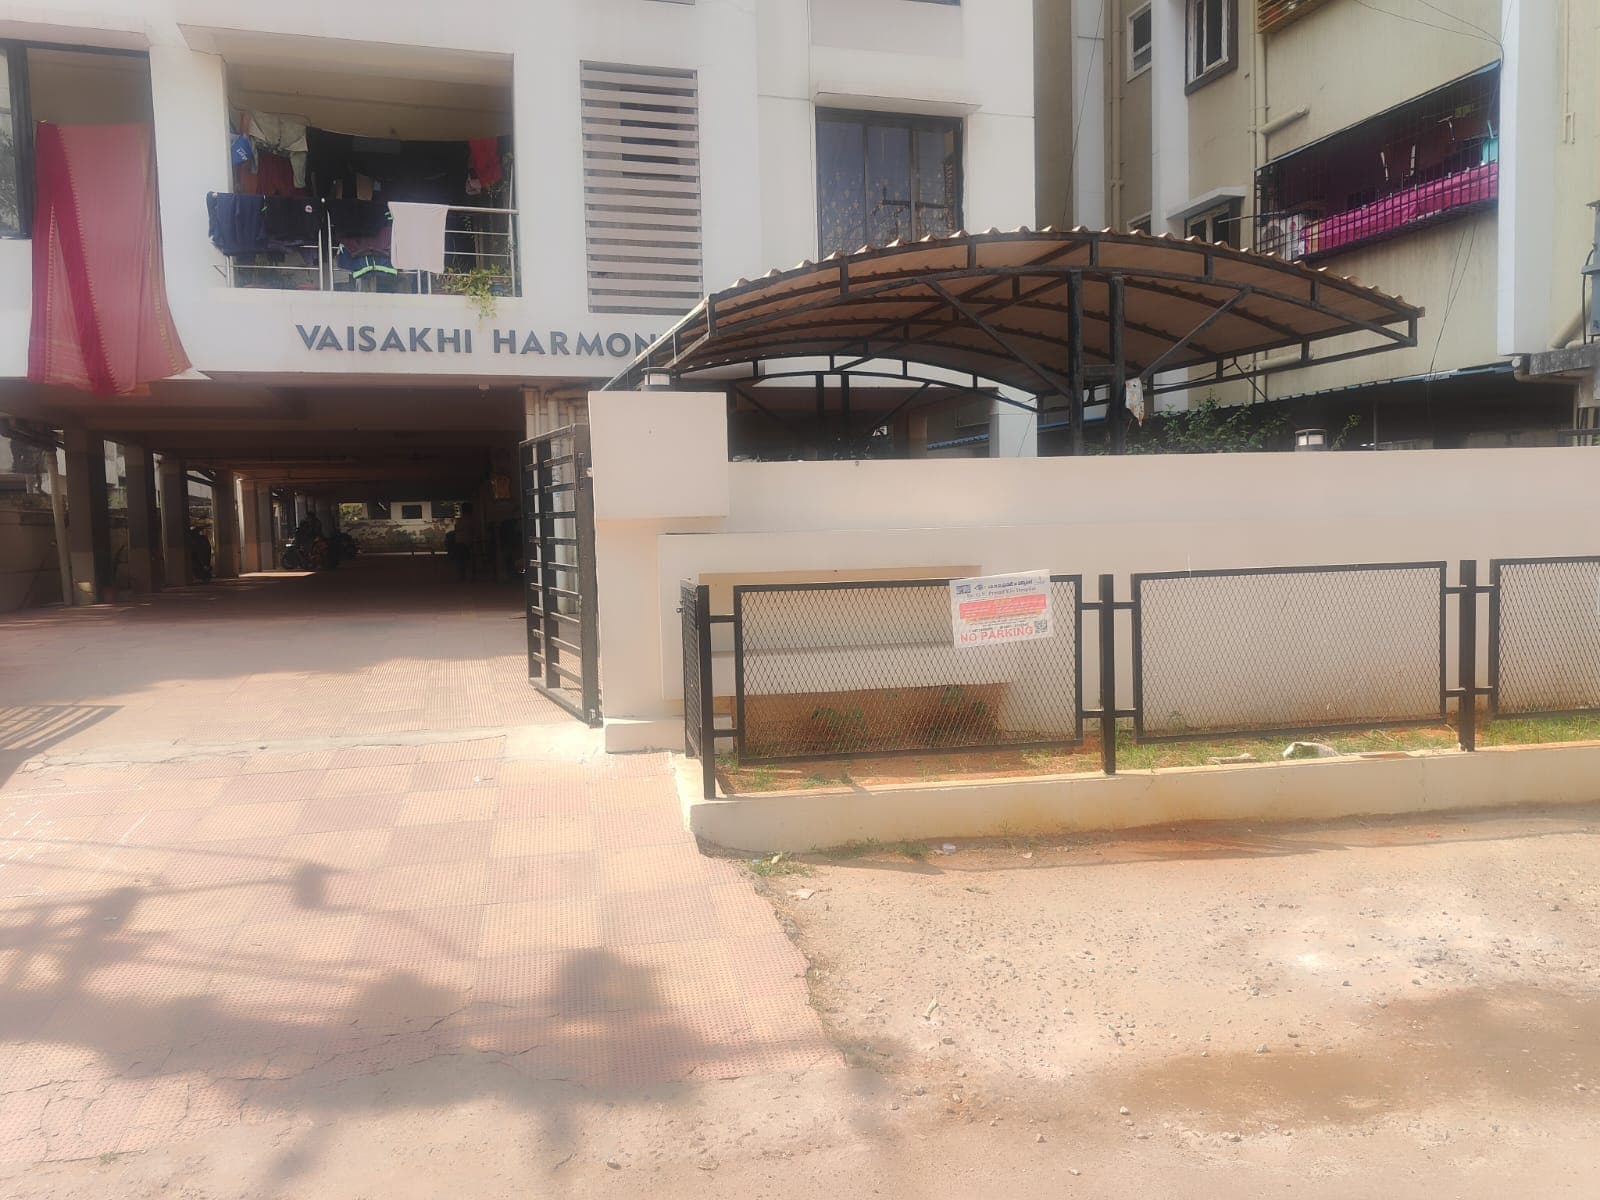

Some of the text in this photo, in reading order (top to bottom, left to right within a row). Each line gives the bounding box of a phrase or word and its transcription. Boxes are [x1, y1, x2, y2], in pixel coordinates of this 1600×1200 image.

[295, 325, 663, 358] VAISAKHI HARMON
[960, 633, 977, 642] NO
[981, 626, 1034, 640] PARKING
